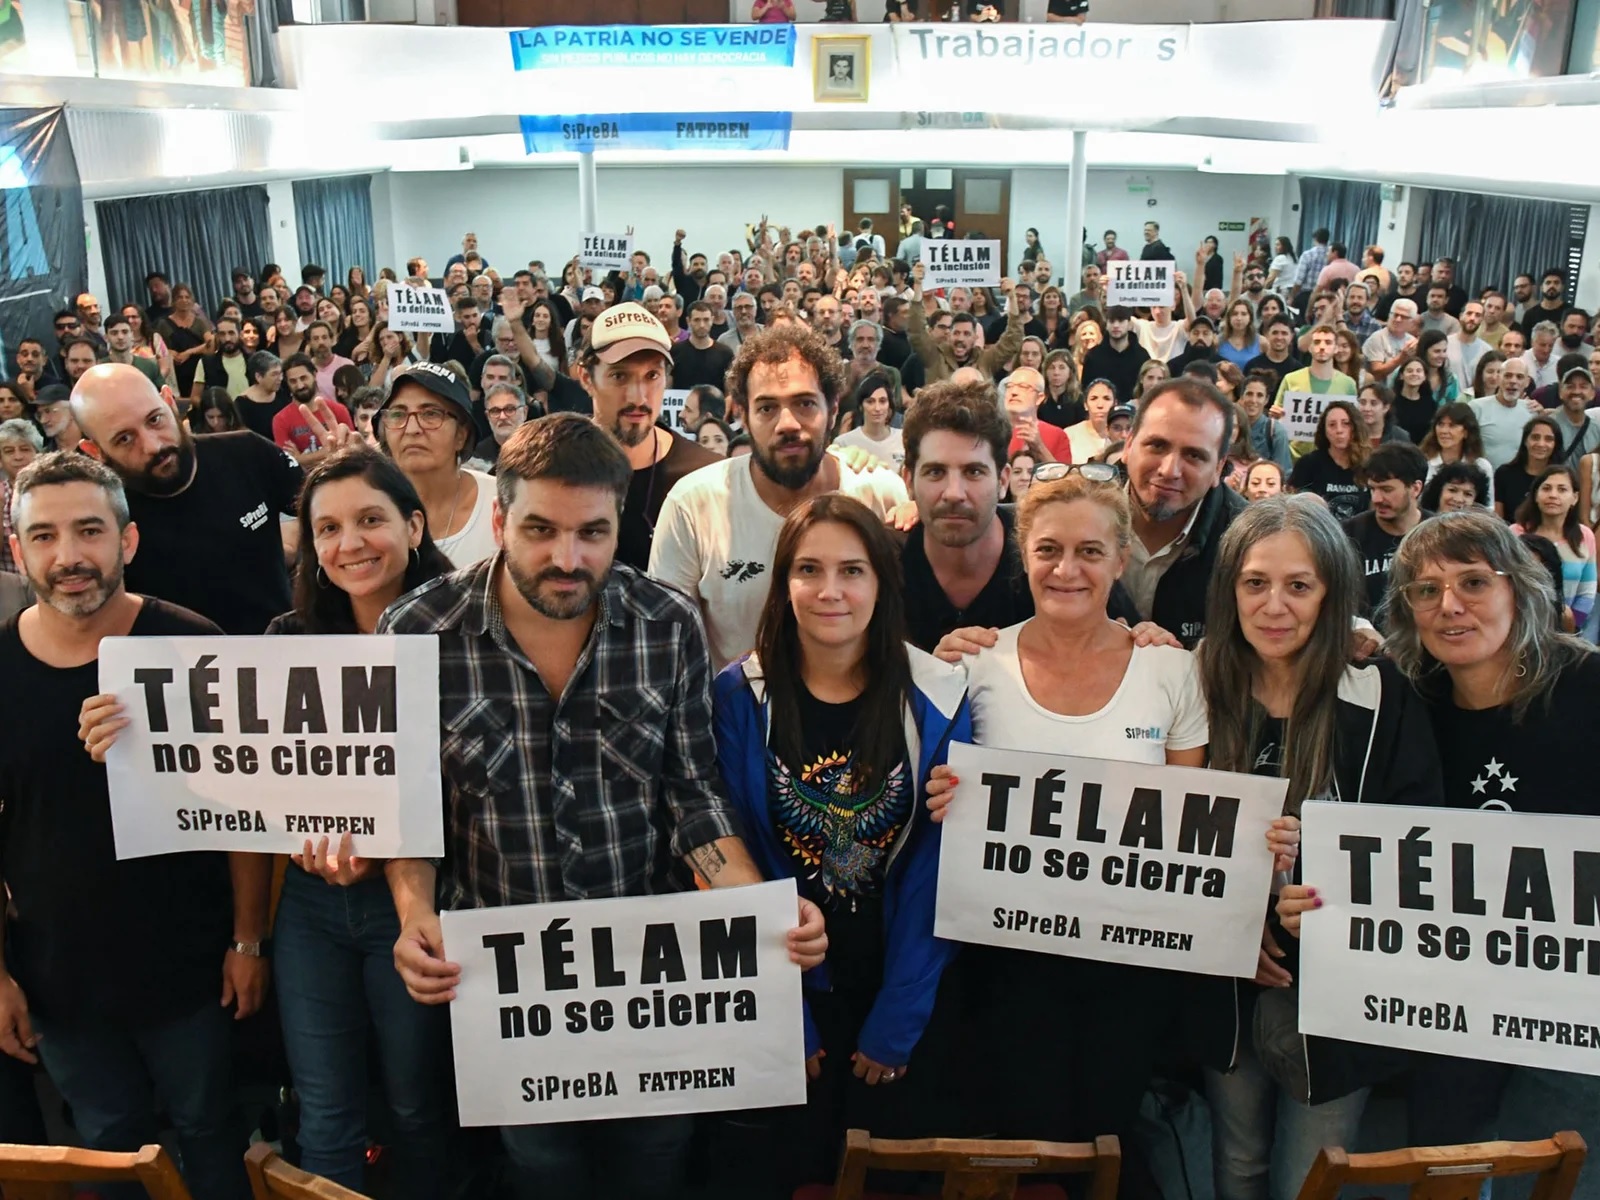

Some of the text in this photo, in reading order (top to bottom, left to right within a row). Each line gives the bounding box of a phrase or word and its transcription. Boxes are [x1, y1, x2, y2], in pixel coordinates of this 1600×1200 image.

[519, 29, 787, 48] LA PATRIA NO SE VENDE
[563, 122, 750, 140] SiPreBA FATPREN
[584, 236, 627, 251] TÉLAM
[929, 244, 990, 262] TÉLAM
[944, 262, 990, 271] inclusión
[1115, 264, 1166, 281] TÉLAM
[395, 288, 443, 306] TÉLAM
[397, 305, 406, 313] se
[1291, 415, 1303, 423] se
[1364, 559, 1381, 576] LA
[134, 655, 398, 734] TÉLAM
[152, 739, 396, 776] no se cierra
[176, 808, 375, 835] SiPreBA FATPREN
[981, 768, 1241, 859] TÉLAM
[983, 841, 1226, 899] no se cierra
[992, 907, 1194, 952] SiPreBA FATPREN
[1349, 916, 1403, 955] no
[1417, 923, 1471, 962] se
[481, 916, 758, 995] TÉLAM
[499, 989, 757, 1039] no se cierra
[1364, 994, 1600, 1049] SiPreBA FATPREN
[521, 1066, 735, 1103] SiPreBA FATPREN
